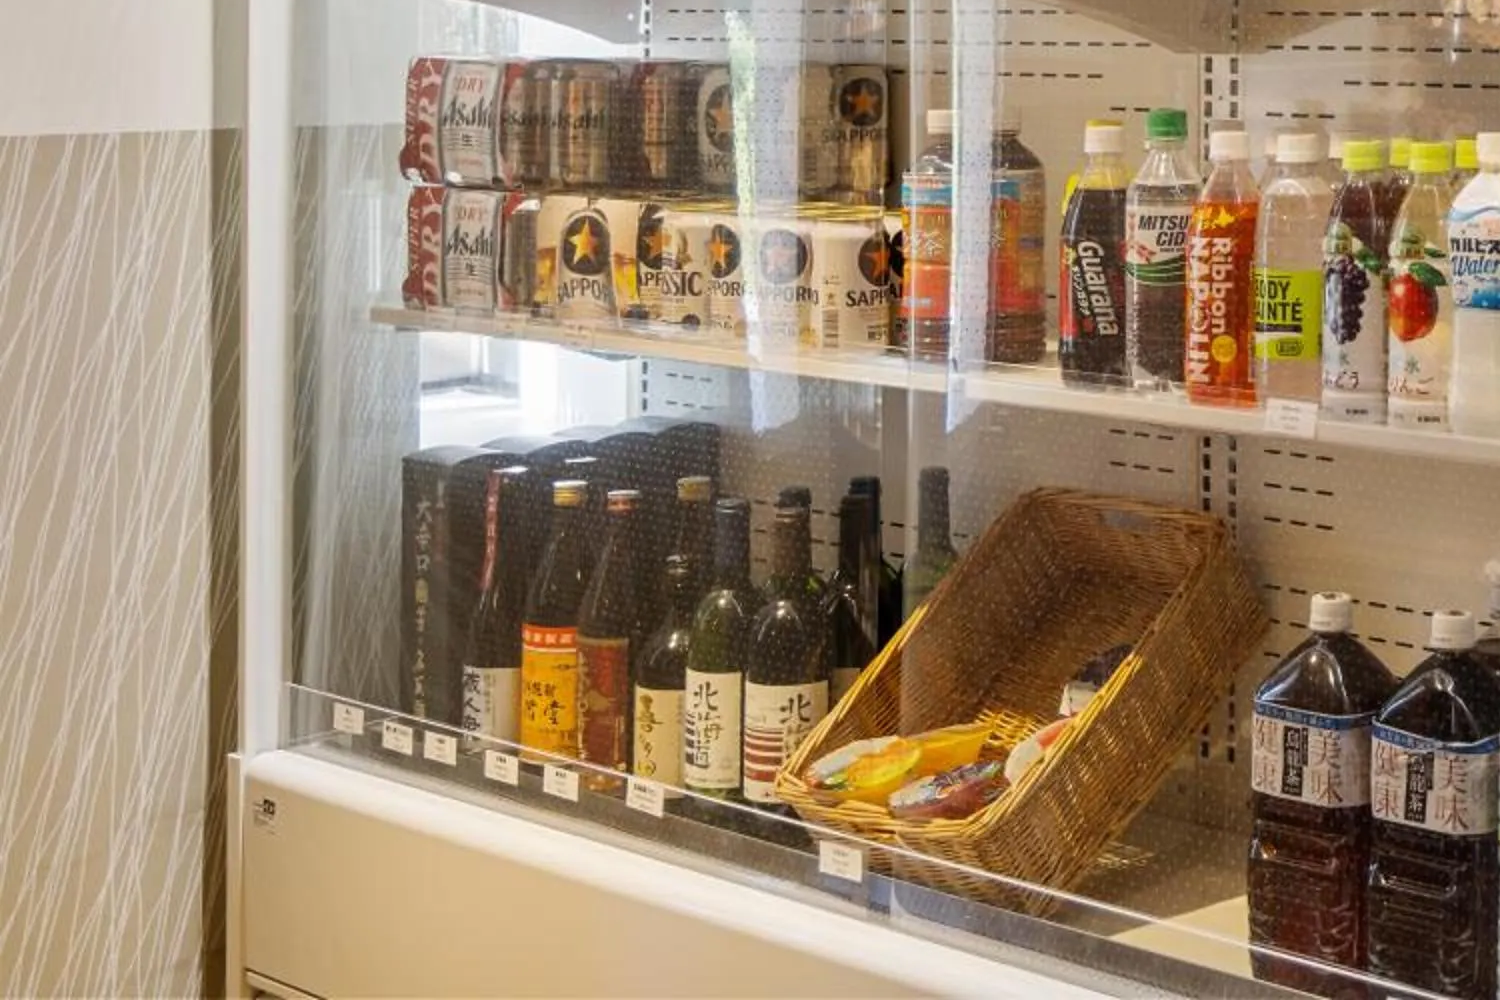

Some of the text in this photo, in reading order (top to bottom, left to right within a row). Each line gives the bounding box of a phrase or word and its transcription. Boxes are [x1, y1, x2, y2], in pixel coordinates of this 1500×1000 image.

[455, 77, 485, 95] DRY
[442, 96, 494, 131] Asahi
[455, 204, 485, 222] DRY
[1138, 215, 1190, 231] MITSU
[446, 223, 494, 258] Asahi
[1155, 231, 1186, 247] CID
[1077, 240, 1119, 336] Guarana
[1211, 236, 1234, 335] Ribbon
[1188, 235, 1211, 385] NAPOLIN
[1310, 731, 1344, 805] 美味
[1434, 756, 1470, 832] 美味
